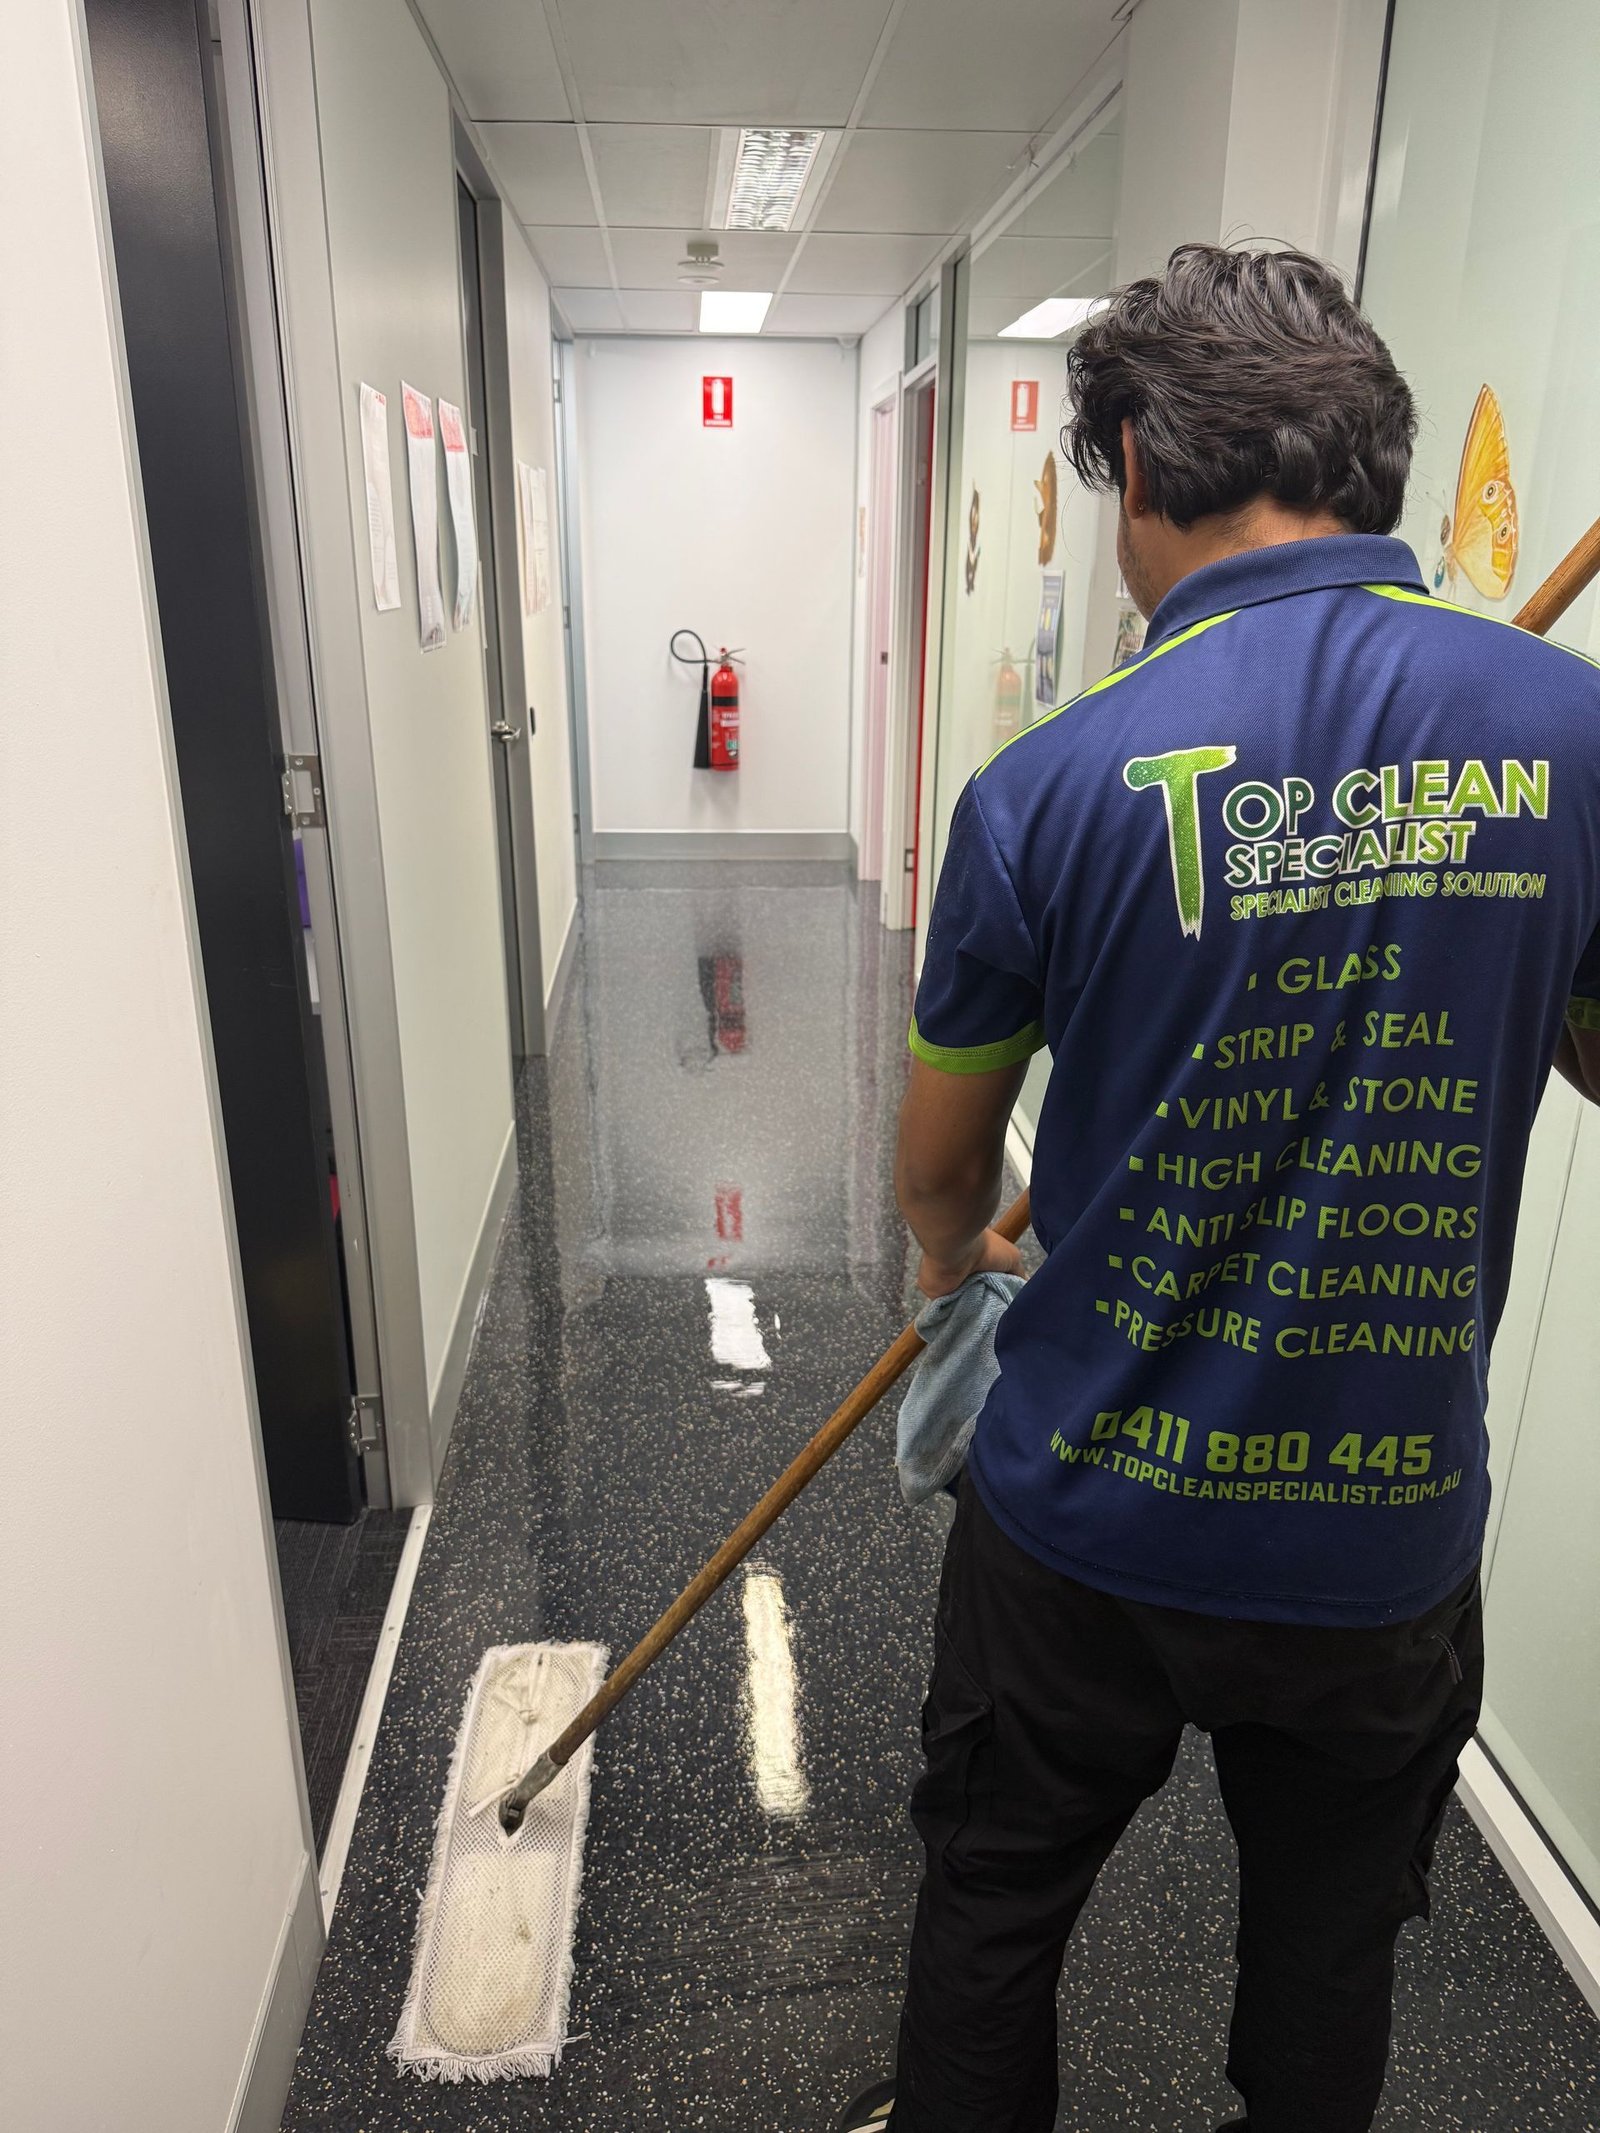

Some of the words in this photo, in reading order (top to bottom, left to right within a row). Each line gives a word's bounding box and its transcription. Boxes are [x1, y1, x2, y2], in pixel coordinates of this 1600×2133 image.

[1123, 745, 1314, 942] TOP
[1332, 760, 1550, 828] CLEAN
[1223, 821, 1475, 888] SPECIALIST
[1230, 885, 1332, 921] SPECIALIST
[1441, 871, 1547, 899] SOLUTION
[1276, 944, 1402, 994] GLASS
[1214, 1022, 1314, 1069] STRIP
[1330, 1021, 1347, 1051] &
[1362, 1010, 1455, 1048] SEAL
[1178, 1088, 1300, 1131] VINYL
[1308, 1082, 1330, 1111] &
[1343, 1076, 1478, 1114] STONE
[1157, 1152, 1261, 1191] HIGH
[1275, 1137, 1482, 1179] CLEANING
[1146, 1207, 1235, 1248] ANTI
[1240, 1196, 1307, 1232] SLIP
[1317, 1203, 1478, 1240] FLOORS
[1131, 1253, 1261, 1301] CARPET
[1267, 1261, 1477, 1300] CLEANING
[1114, 1299, 1261, 1353] PRESSURE
[1274, 1319, 1476, 1359] CLEANING
[1050, 1427, 1462, 1506] WWW.TOPCLEANSPECIALIST.COM.AU
[1091, 1405, 1190, 1464] 0411
[1205, 1430, 1310, 1474] 880
[1328, 1432, 1434, 1477] 445
